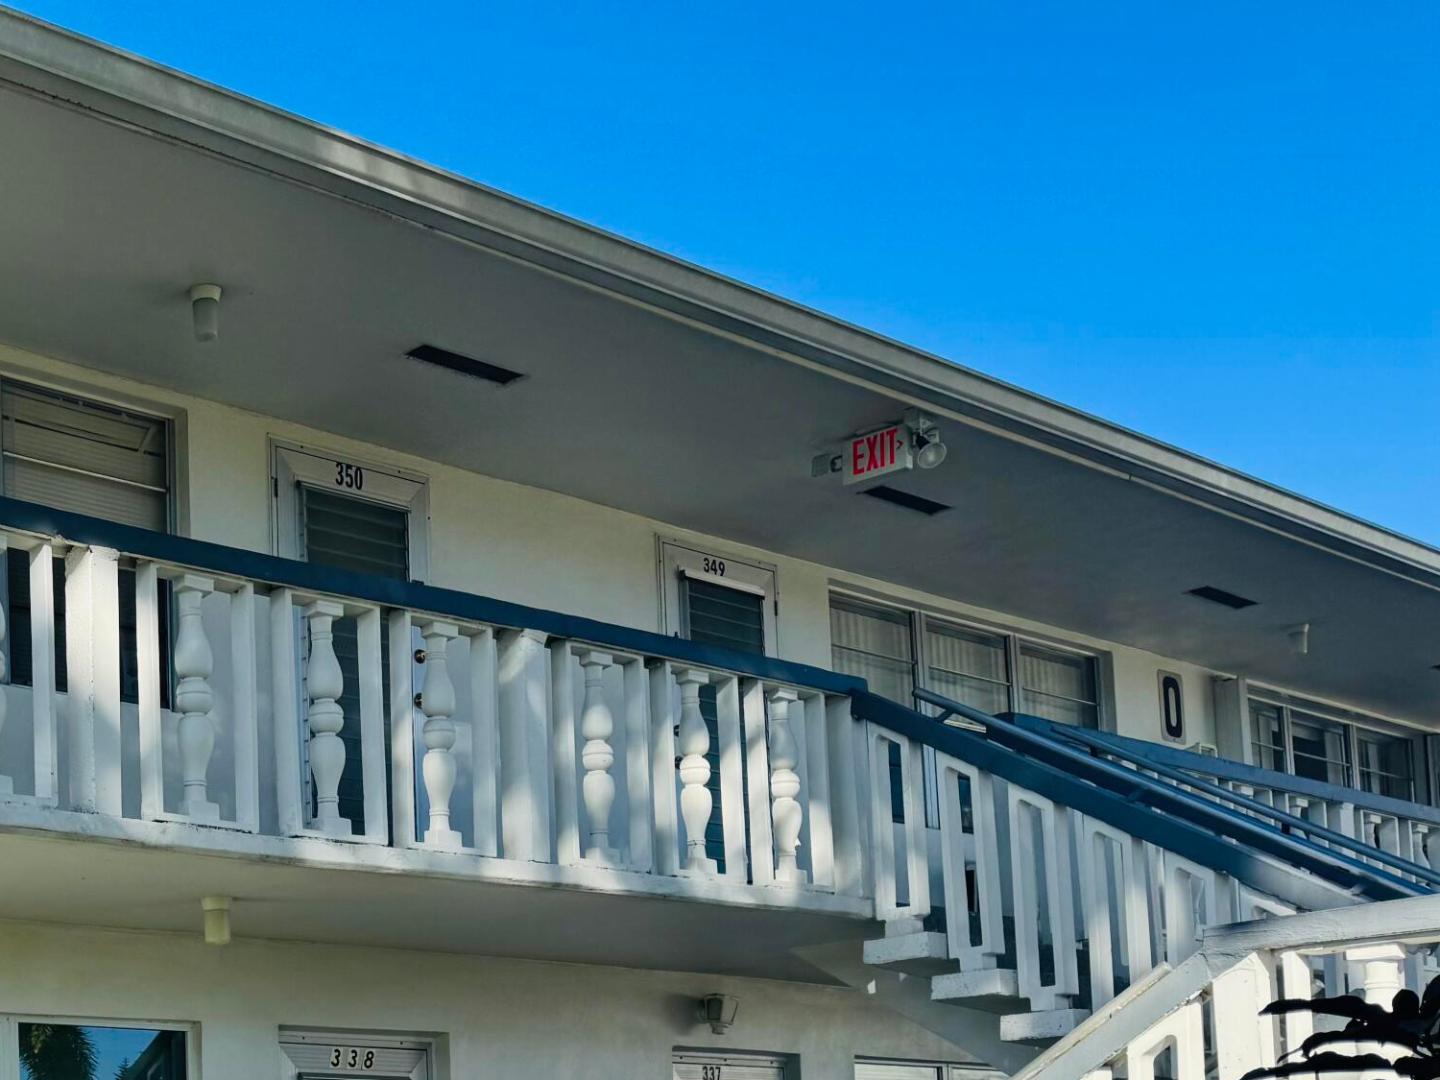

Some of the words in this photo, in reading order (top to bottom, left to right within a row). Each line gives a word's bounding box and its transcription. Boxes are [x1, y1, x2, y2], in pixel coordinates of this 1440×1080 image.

[852, 428, 898, 476] EXIT
[335, 462, 364, 490] 350
[703, 557, 725, 577] 349
[331, 1049, 375, 1069] 338
